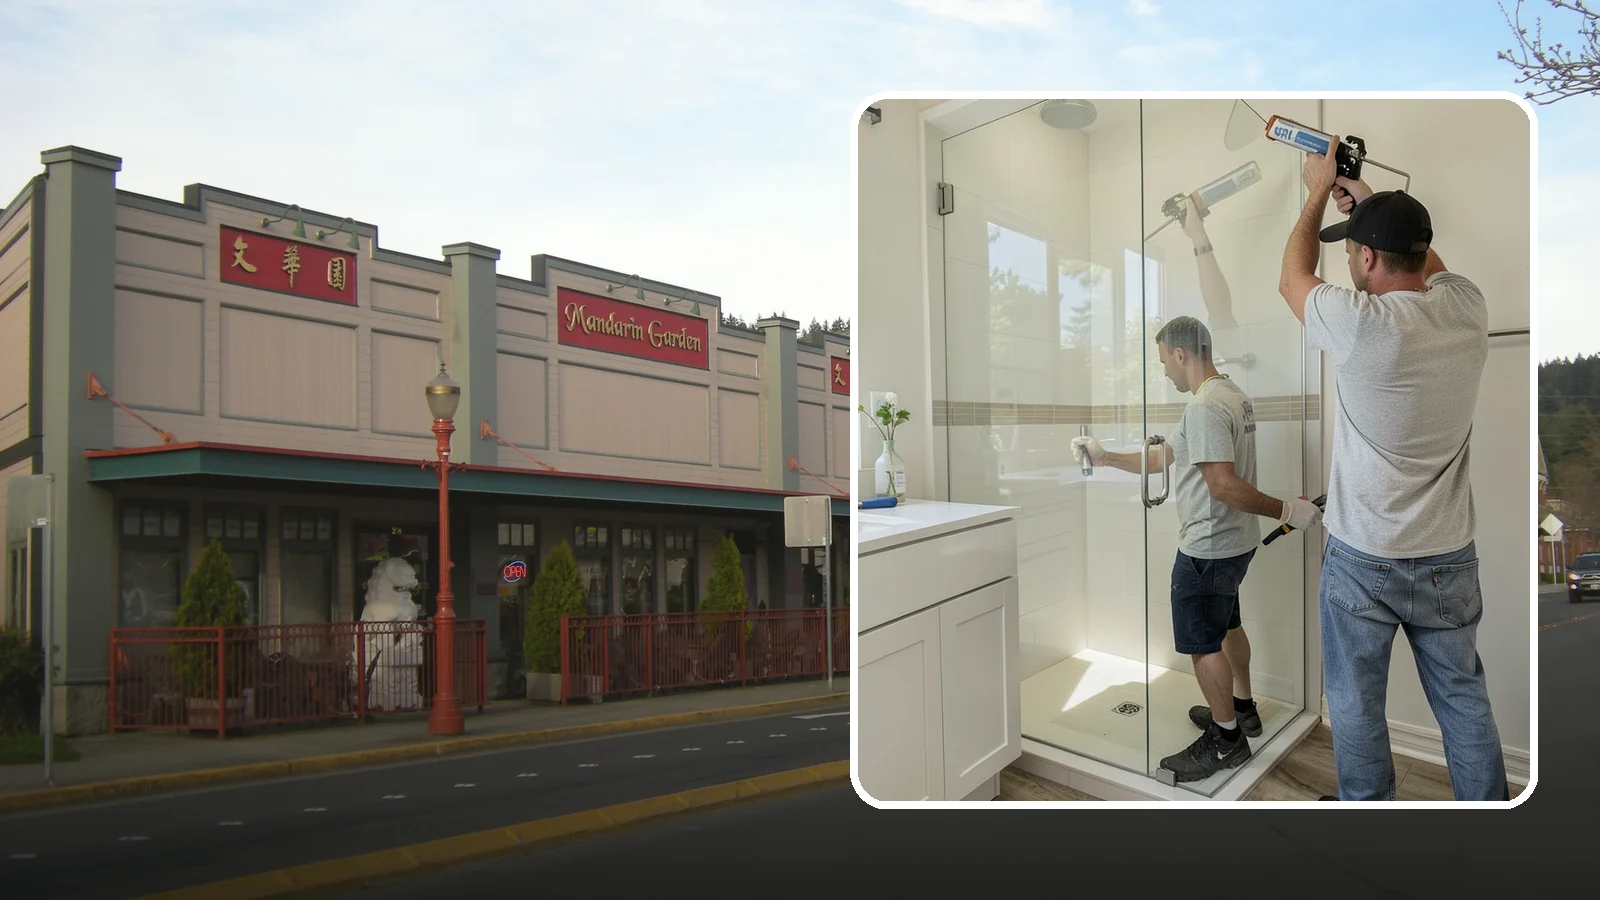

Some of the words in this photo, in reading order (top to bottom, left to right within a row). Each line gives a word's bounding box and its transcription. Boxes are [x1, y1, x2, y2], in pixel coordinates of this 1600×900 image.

[230, 235, 346, 291] 文華園
[564, 302, 644, 341] Mandarin
[647, 320, 701, 352] Garden
[503, 564, 527, 578] OPEN
